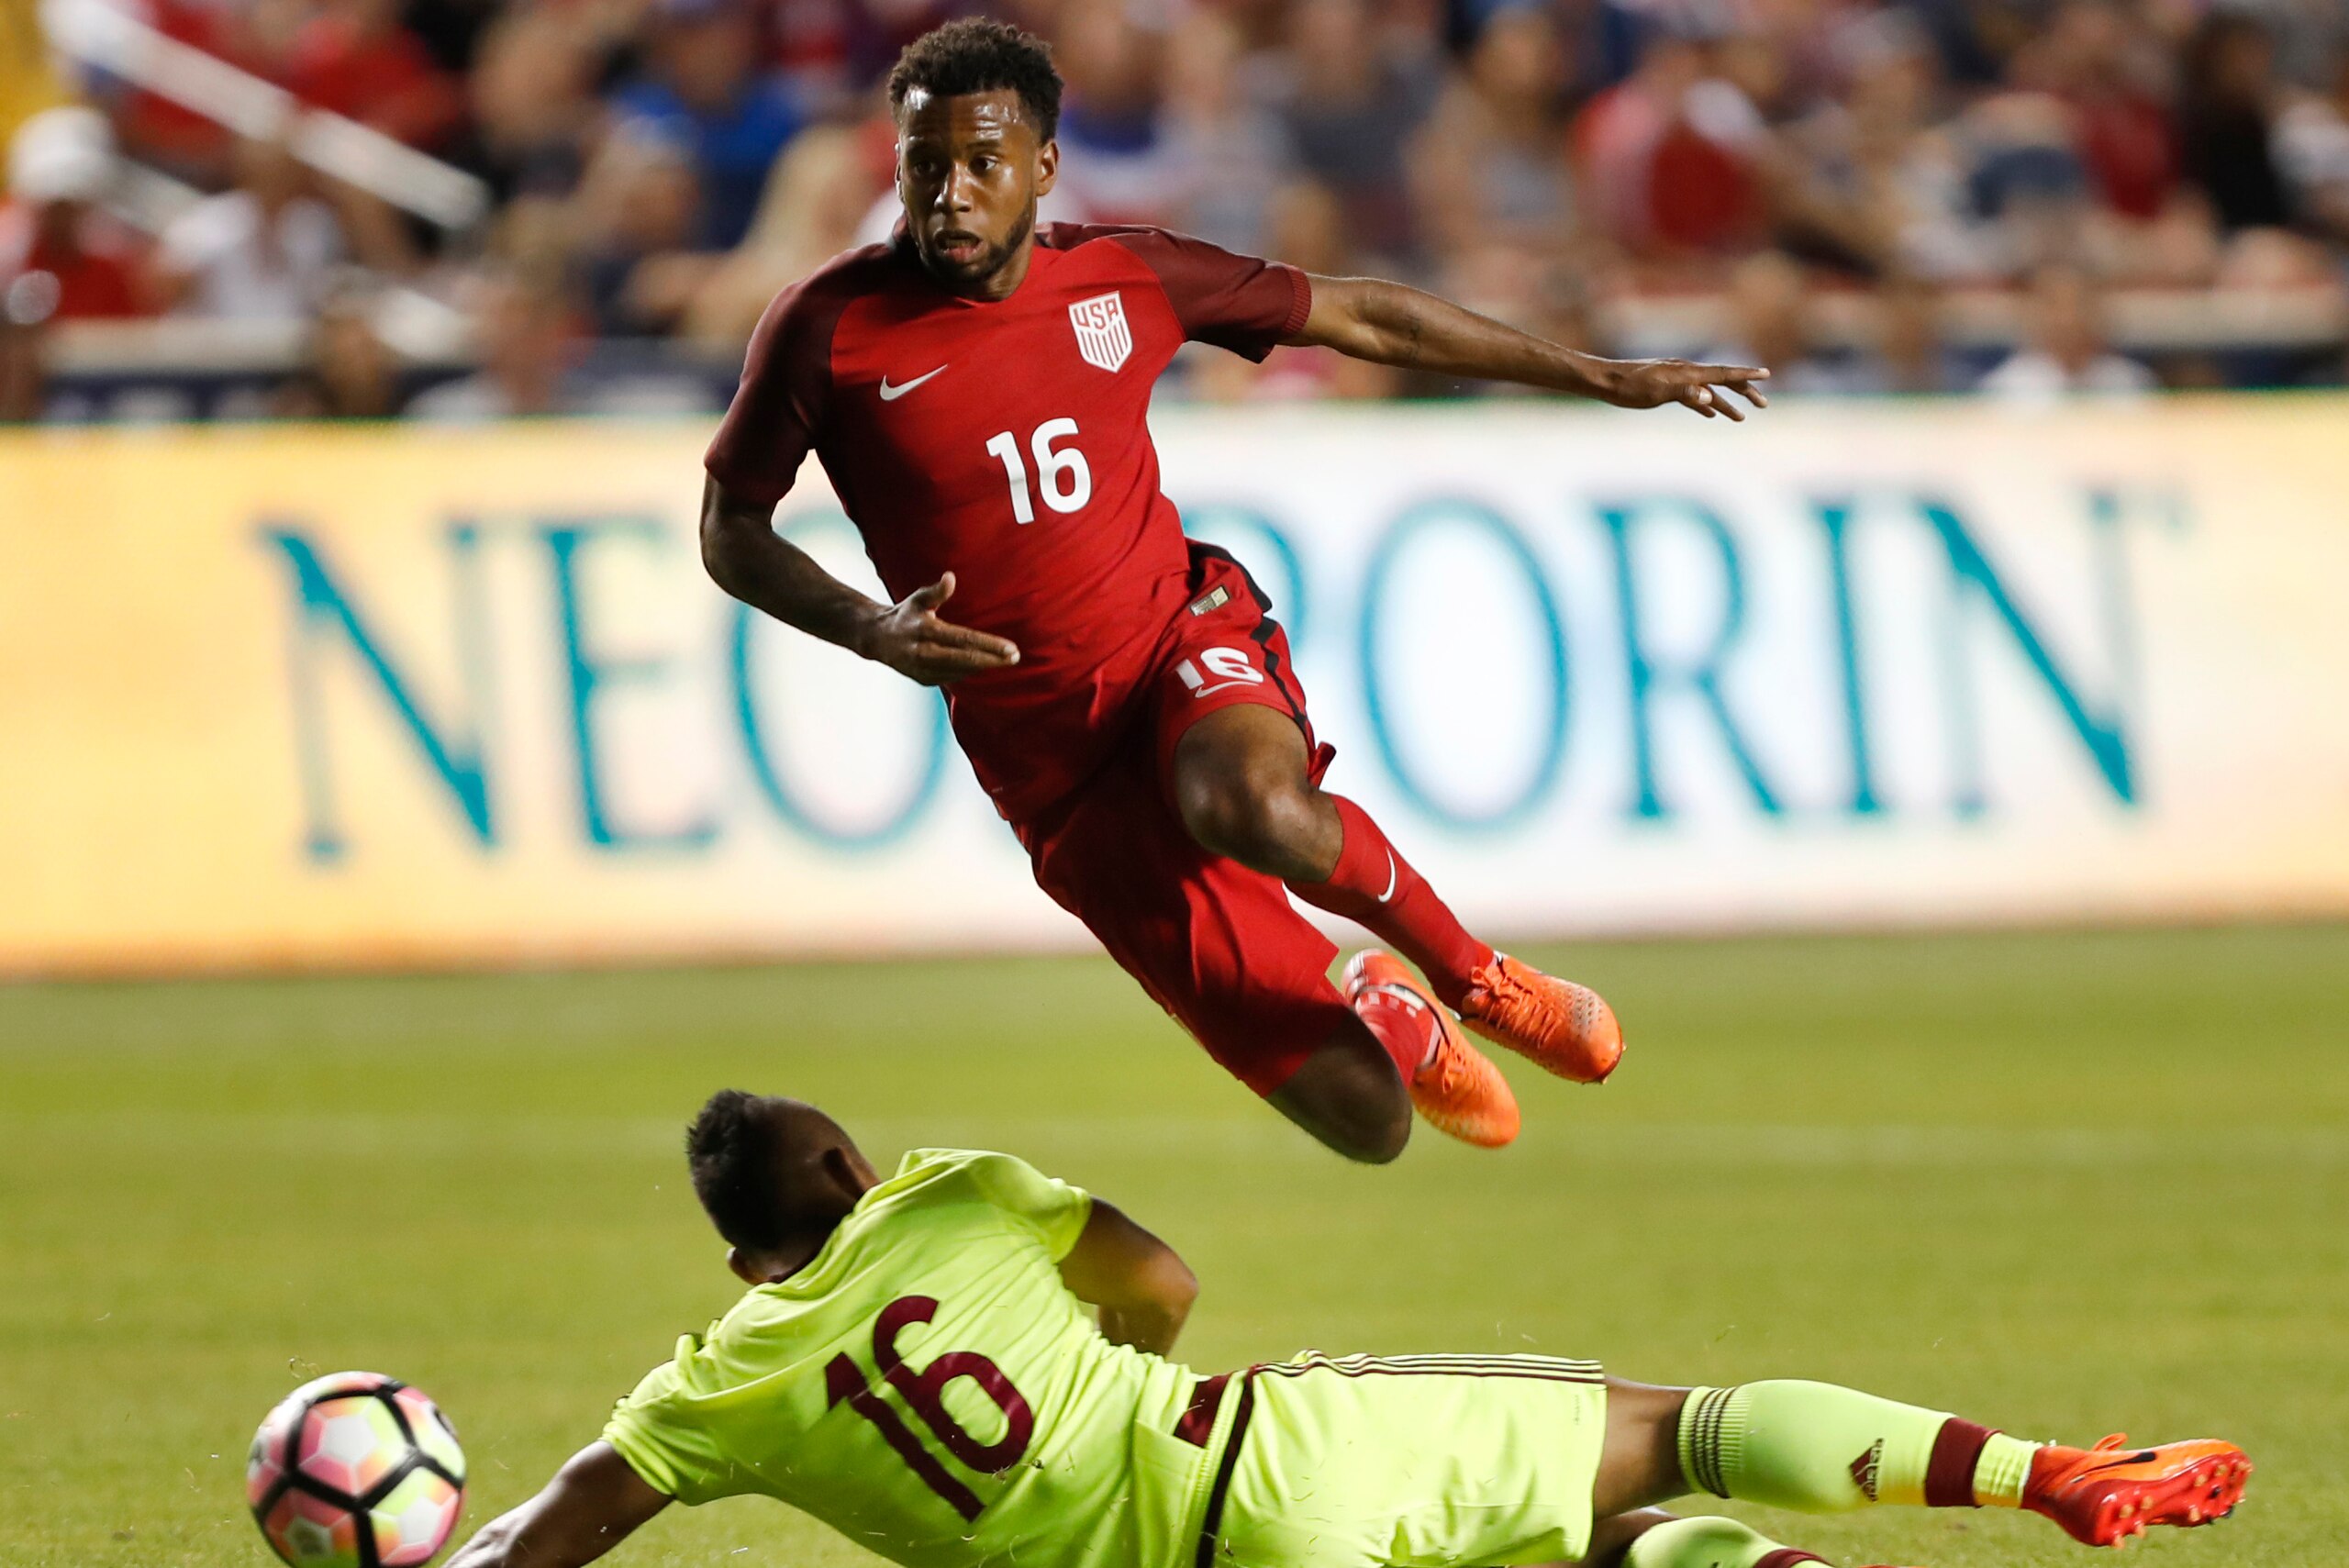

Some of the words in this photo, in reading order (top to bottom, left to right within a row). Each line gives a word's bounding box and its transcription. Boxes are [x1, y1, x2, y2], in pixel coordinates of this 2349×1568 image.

[1072, 298, 1119, 330] USA
[985, 417, 1092, 525] 16
[253, 491, 2149, 864] NEOORIN
[1174, 647, 1264, 691] 16
[824, 1295, 1033, 1523] 16
